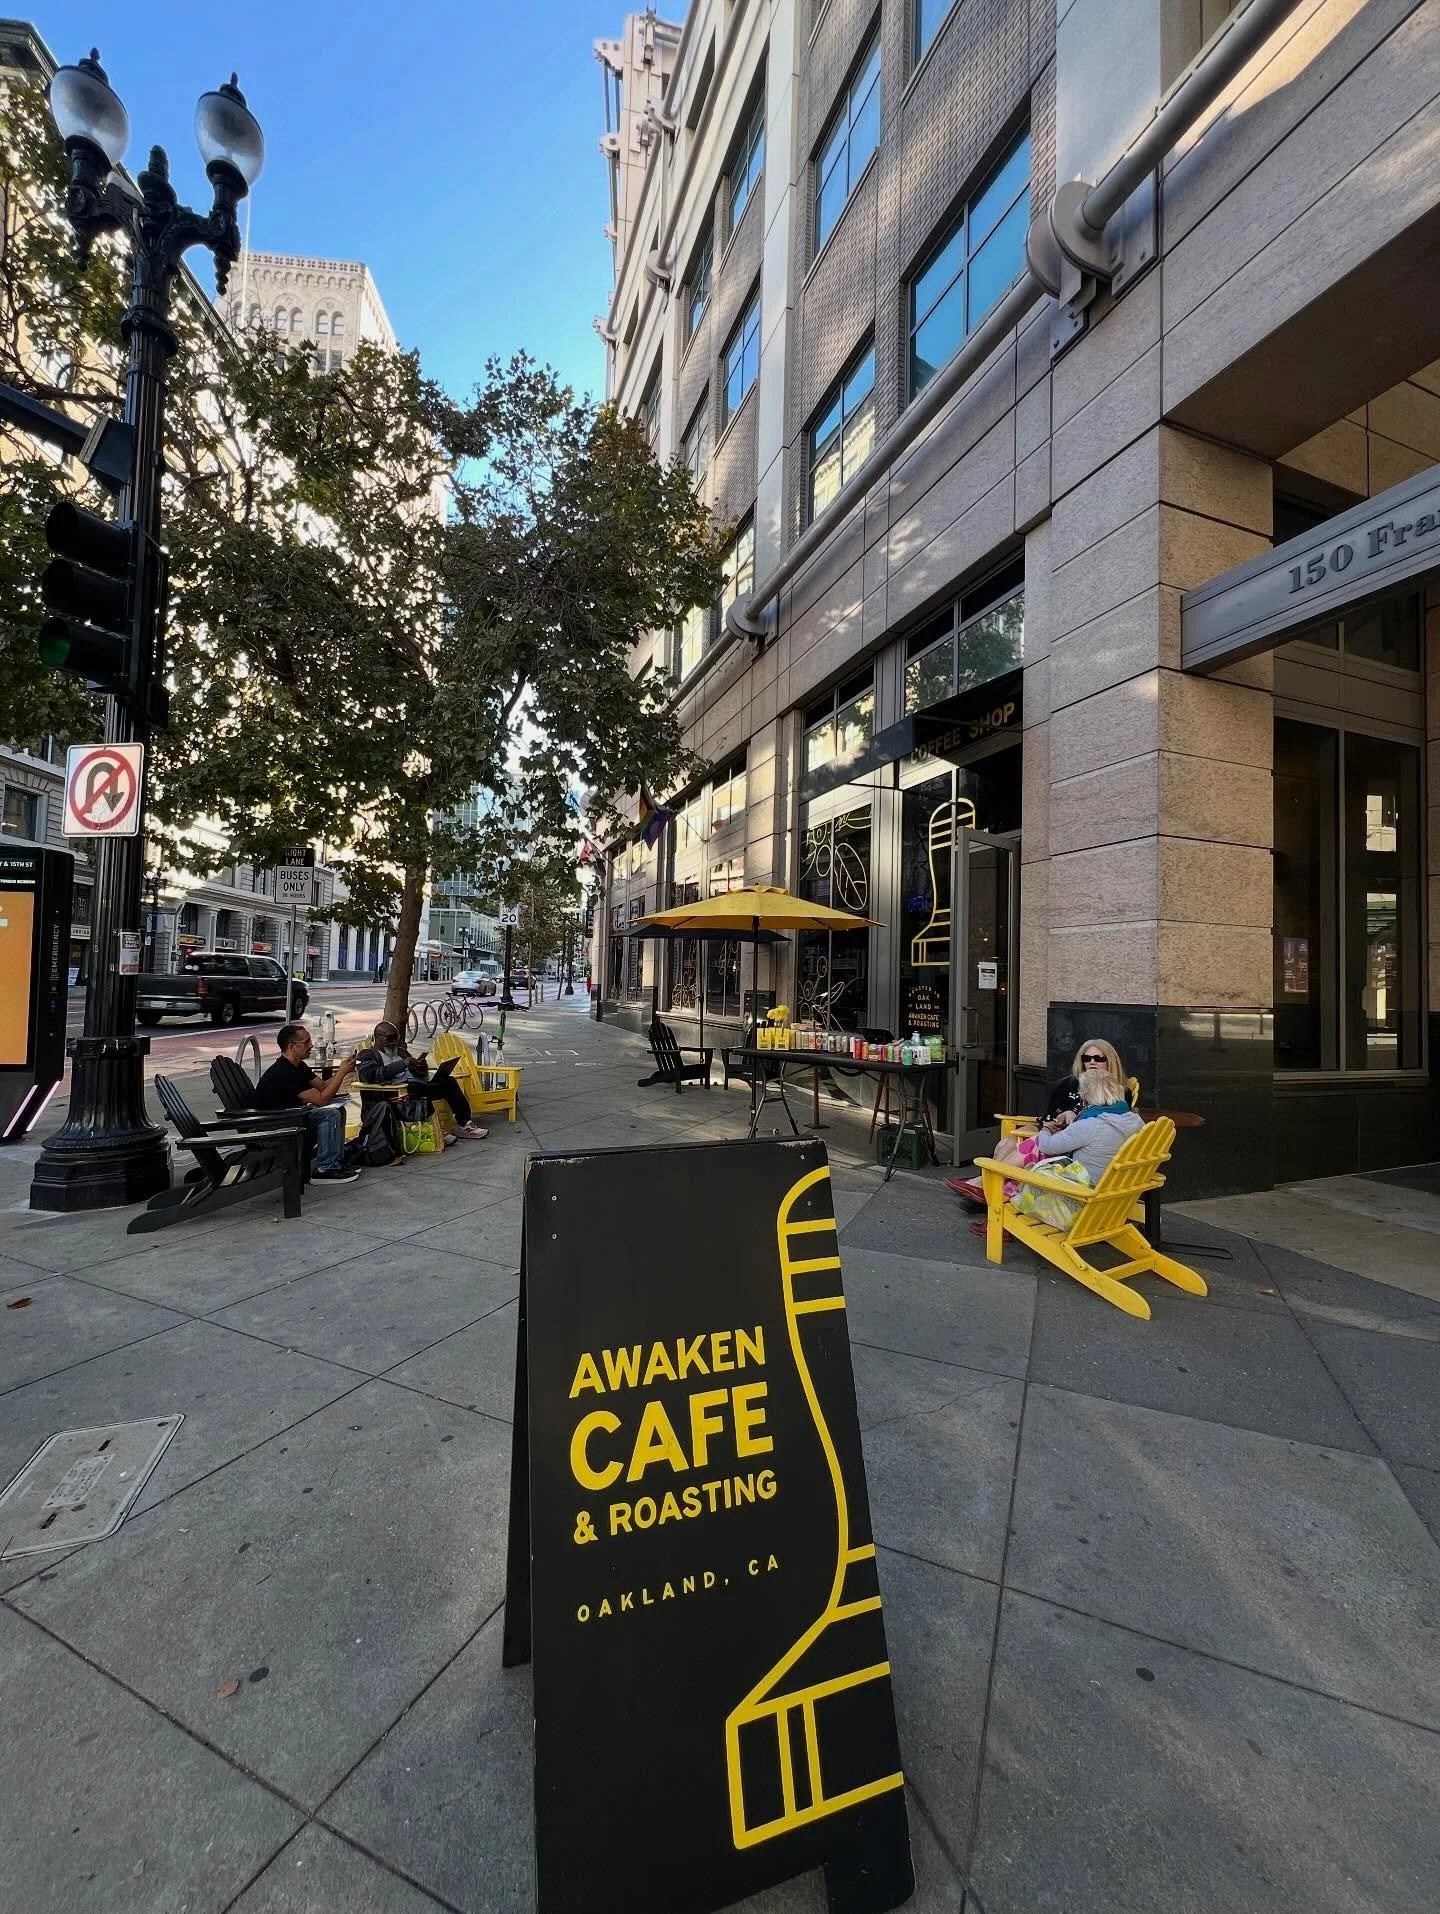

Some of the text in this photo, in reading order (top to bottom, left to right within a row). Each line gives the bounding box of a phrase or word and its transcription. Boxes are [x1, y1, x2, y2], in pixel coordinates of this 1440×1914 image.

[1288, 544, 1354, 594] 150
[911, 702, 1015, 764] COFFEE SHOP
[280, 870, 309, 880] BUSES
[283, 881, 305, 891] ONLY
[285, 858, 305, 866] LANE
[501, 913, 516, 922] 20
[51, 924, 60, 973] EMERGENCY
[914, 1020, 940, 1029] ROASTING
[569, 1325, 766, 1399] AWAKEN
[570, 1381, 774, 1491] CAFE
[573, 1468, 778, 1545] & ROASTING
[576, 1553, 779, 1622] OAKLAND, CA
